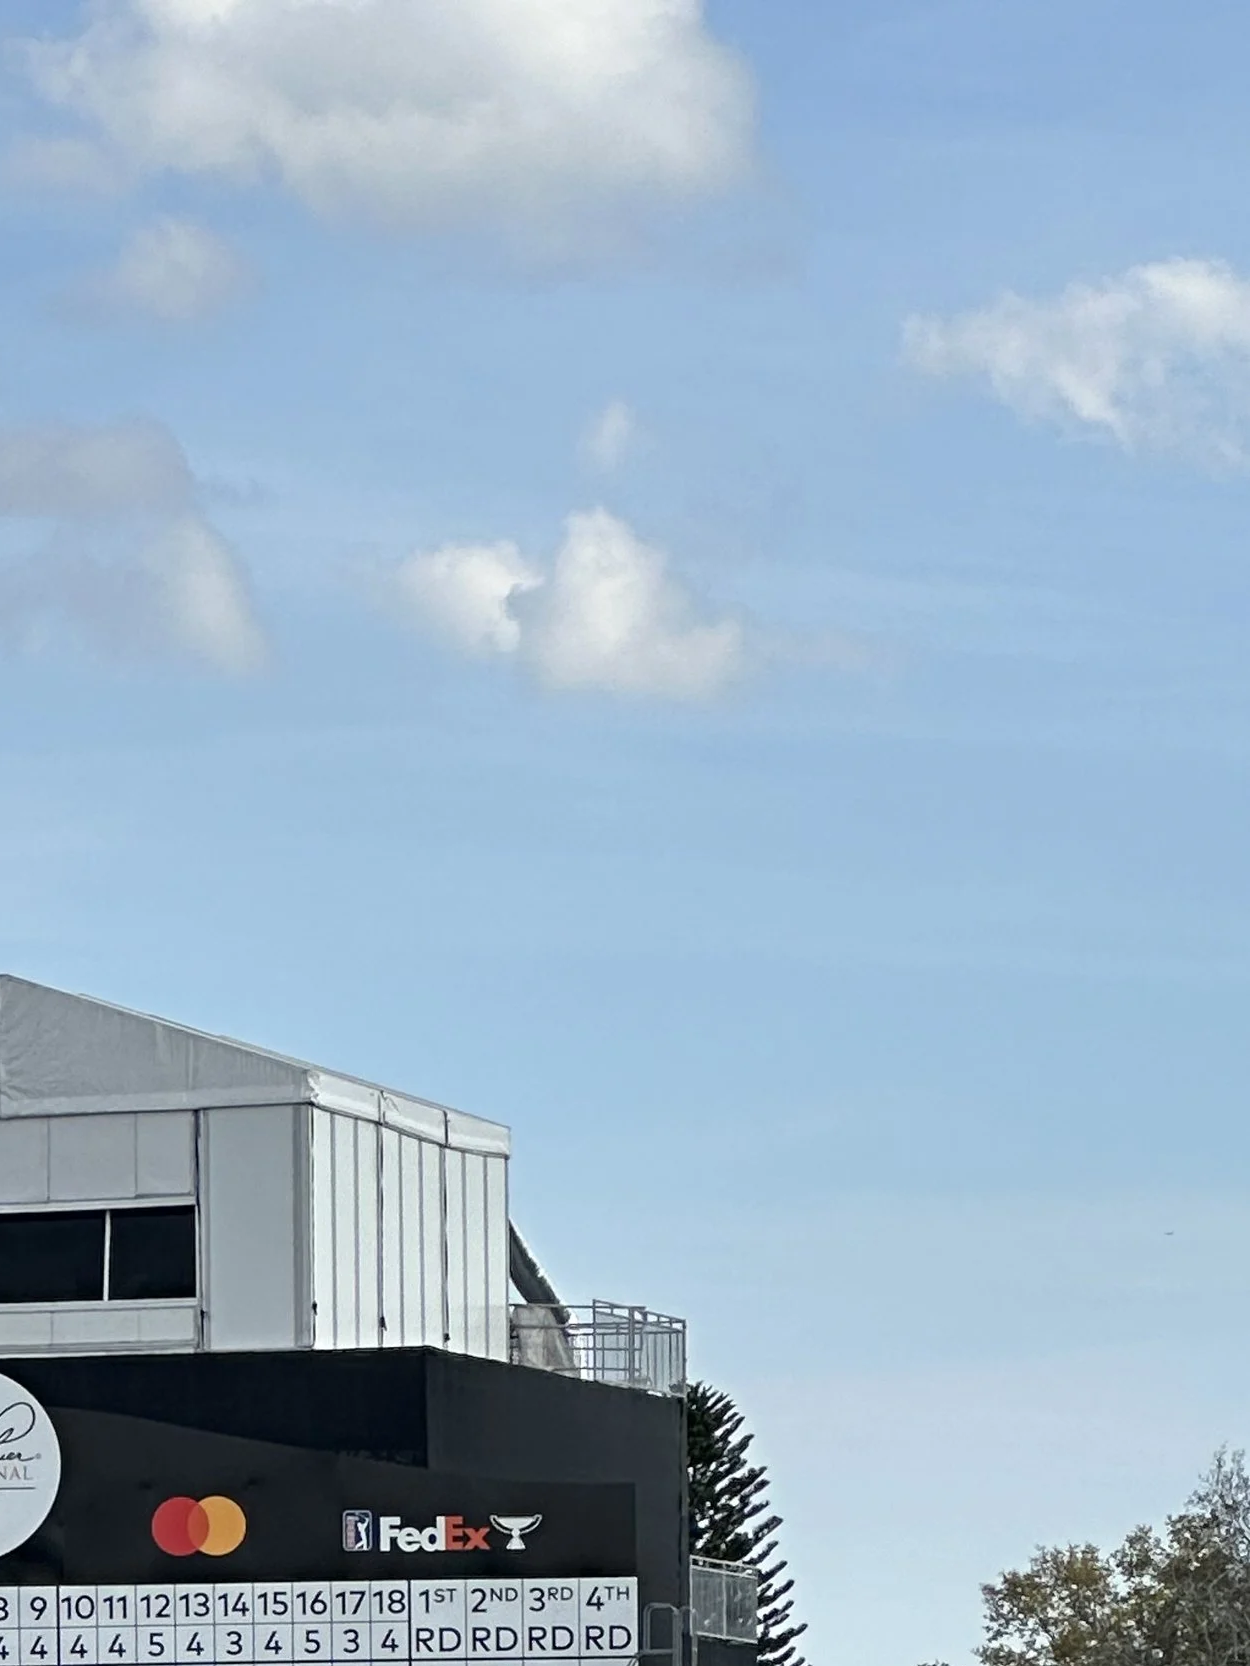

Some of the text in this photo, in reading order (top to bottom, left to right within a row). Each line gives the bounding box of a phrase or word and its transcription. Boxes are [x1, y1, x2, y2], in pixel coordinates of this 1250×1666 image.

[379, 1516, 490, 1552] FedEx
[30, 1597, 47, 1620] 9
[61, 1595, 94, 1619] 10
[103, 1596, 127, 1619] 11
[141, 1594, 170, 1618] 12
[180, 1593, 209, 1617] 13
[218, 1593, 249, 1616] 14
[258, 1592, 288, 1615] 15
[297, 1591, 327, 1614] 16
[336, 1591, 365, 1614] 17
[374, 1590, 405, 1614] 18
[30, 1636, 47, 1659] 4
[71, 1635, 87, 1658] 4
[109, 1634, 126, 1657] 4
[149, 1633, 164, 1656] 5
[187, 1632, 204, 1655] 4
[227, 1631, 242, 1655] 3
[265, 1631, 282, 1654] 4
[305, 1630, 320, 1653] 5
[344, 1629, 359, 1653] 3
[381, 1629, 398, 1652] 4
[416, 1628, 461, 1652] RD
[472, 1627, 517, 1651] RD
[529, 1626, 573, 1651] RD
[586, 1626, 631, 1650] RD
